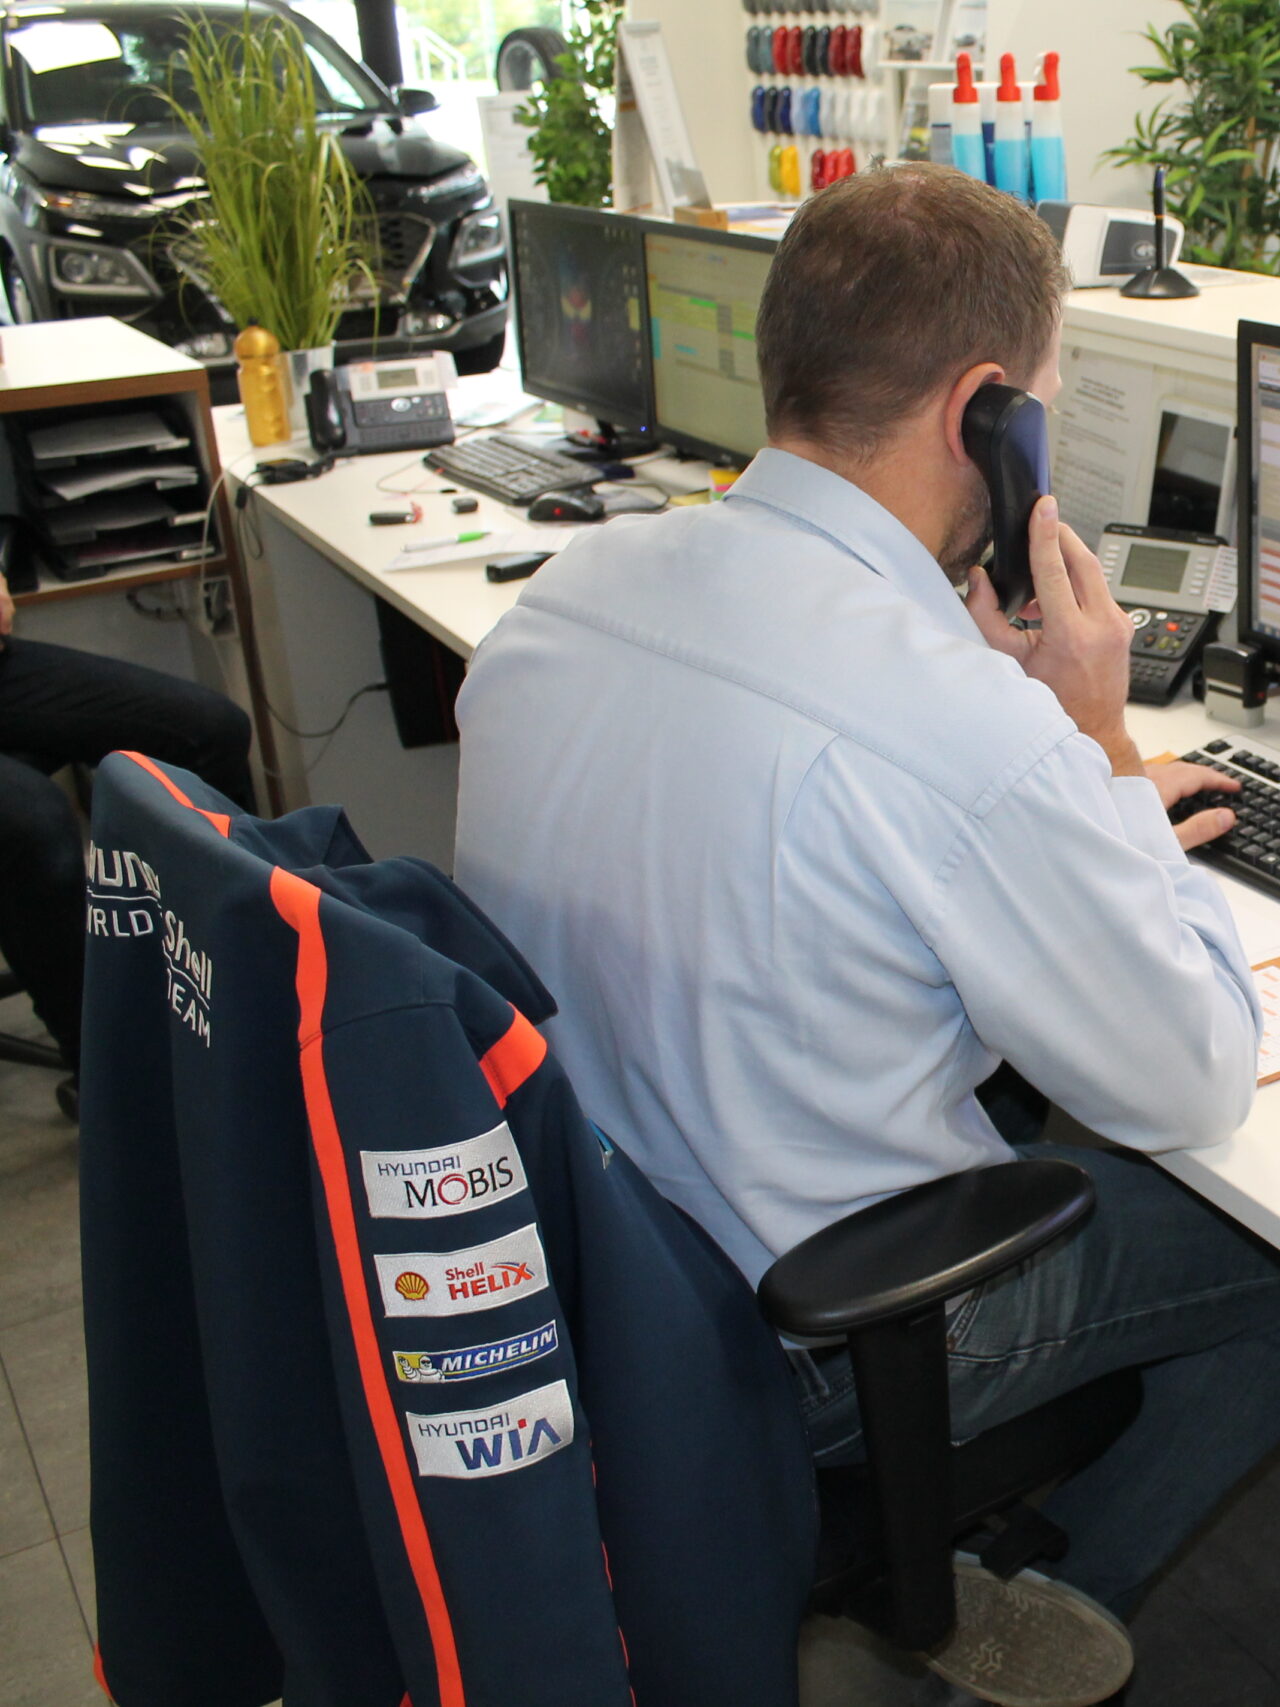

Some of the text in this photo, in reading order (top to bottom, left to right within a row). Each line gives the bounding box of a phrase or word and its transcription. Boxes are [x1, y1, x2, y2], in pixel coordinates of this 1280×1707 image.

[165, 910, 212, 1000] Shell
[377, 1155, 461, 1177] HYUNDAI
[404, 1157, 514, 1208] MOBIS
[445, 1262, 484, 1281] Shell
[449, 1263, 535, 1300] HELIX
[441, 1326, 554, 1373] MICHELIN
[418, 1412, 510, 1437] HYUNDAI
